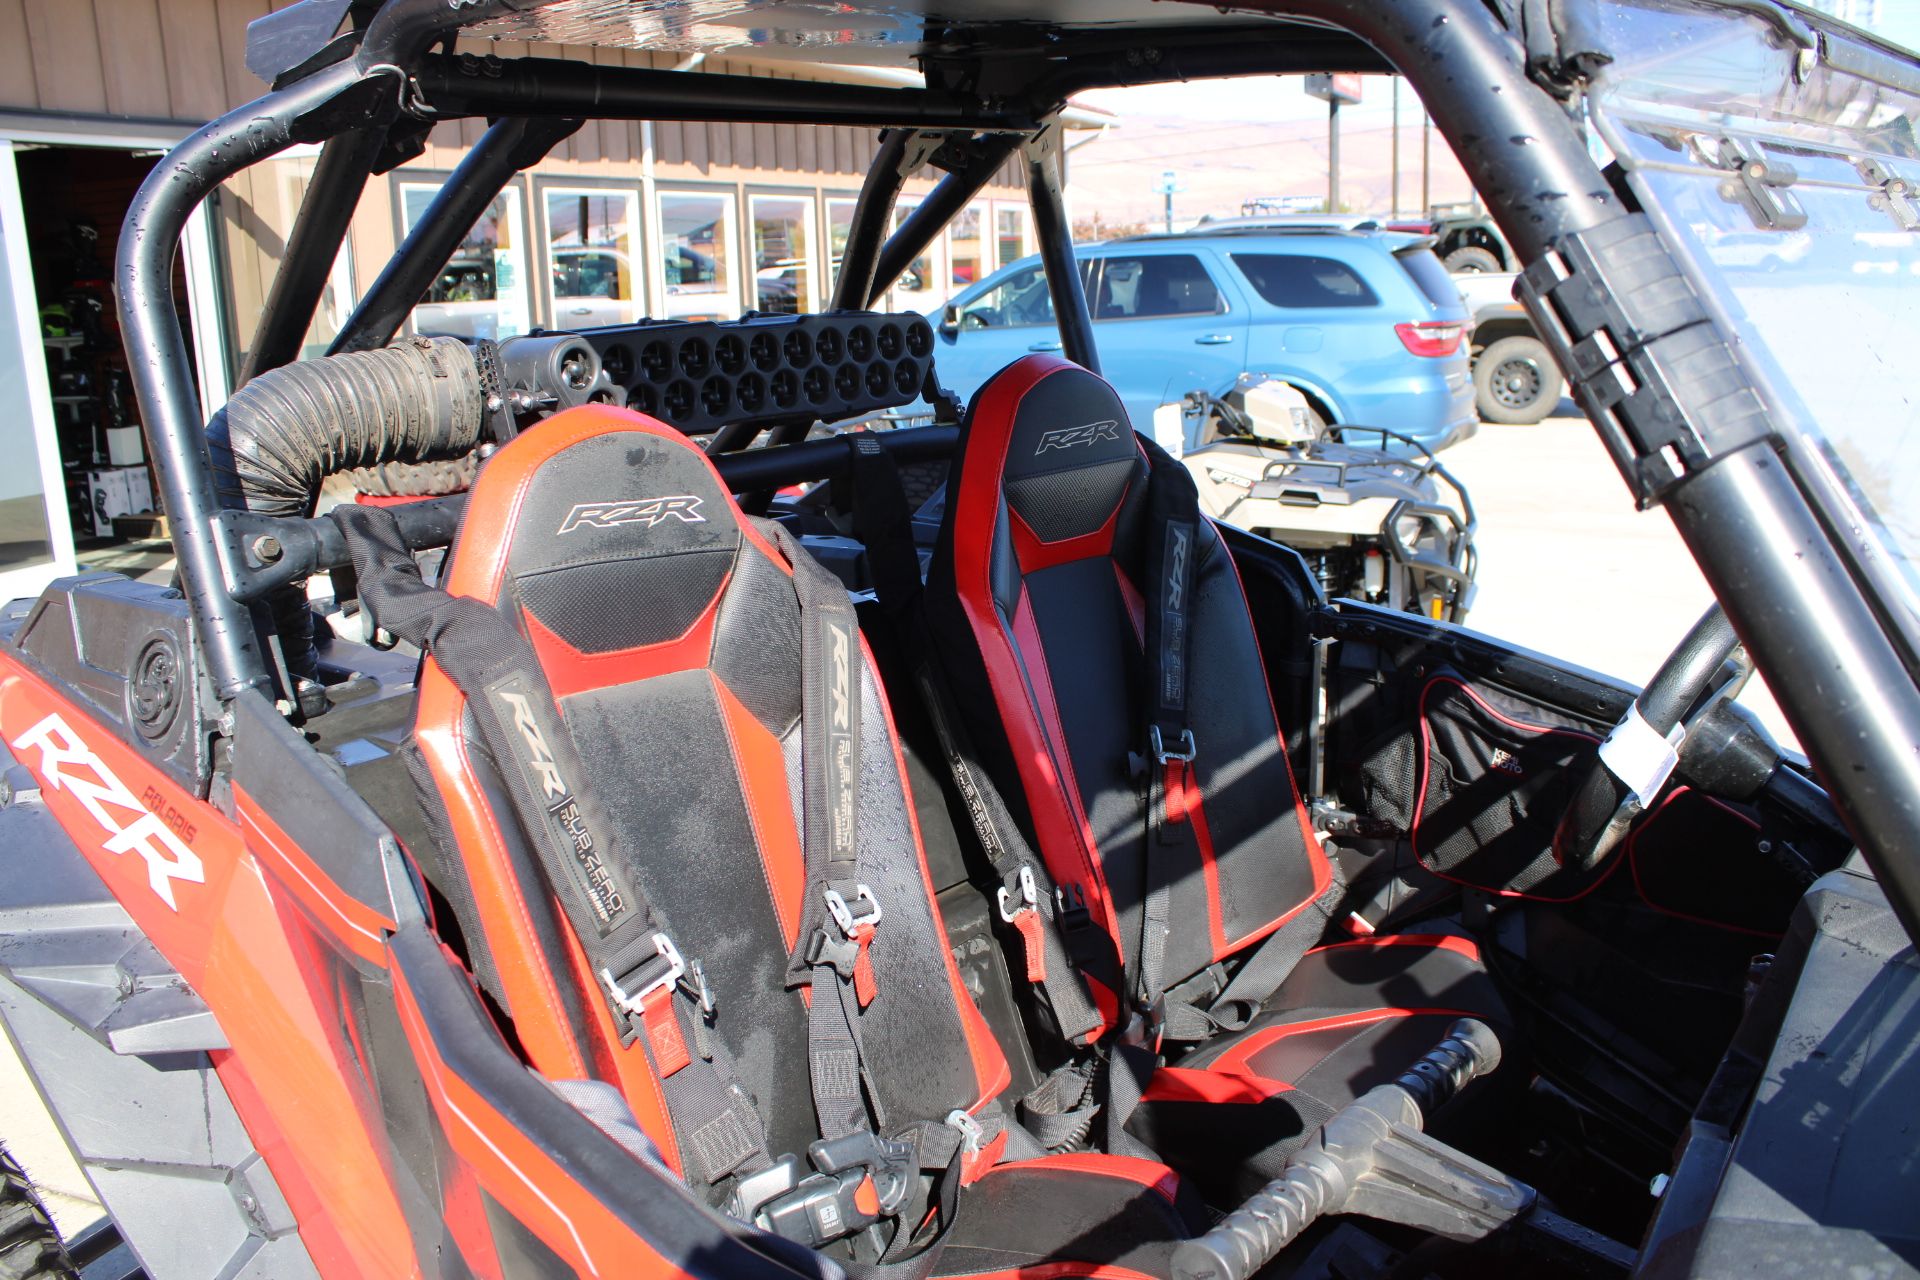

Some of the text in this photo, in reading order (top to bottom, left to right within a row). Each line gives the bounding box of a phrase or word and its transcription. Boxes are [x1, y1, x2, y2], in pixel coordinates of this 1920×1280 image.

[1035, 420, 1119, 455] RZR
[557, 495, 706, 535] RZR
[1169, 527, 1186, 610] RZR
[830, 623, 848, 730] RZR
[499, 692, 566, 799] RZR
[11, 712, 205, 912] RZR
[142, 786, 198, 844] POLARIS
[560, 809, 585, 859] CONTROLLED
[565, 803, 592, 850] SUB
